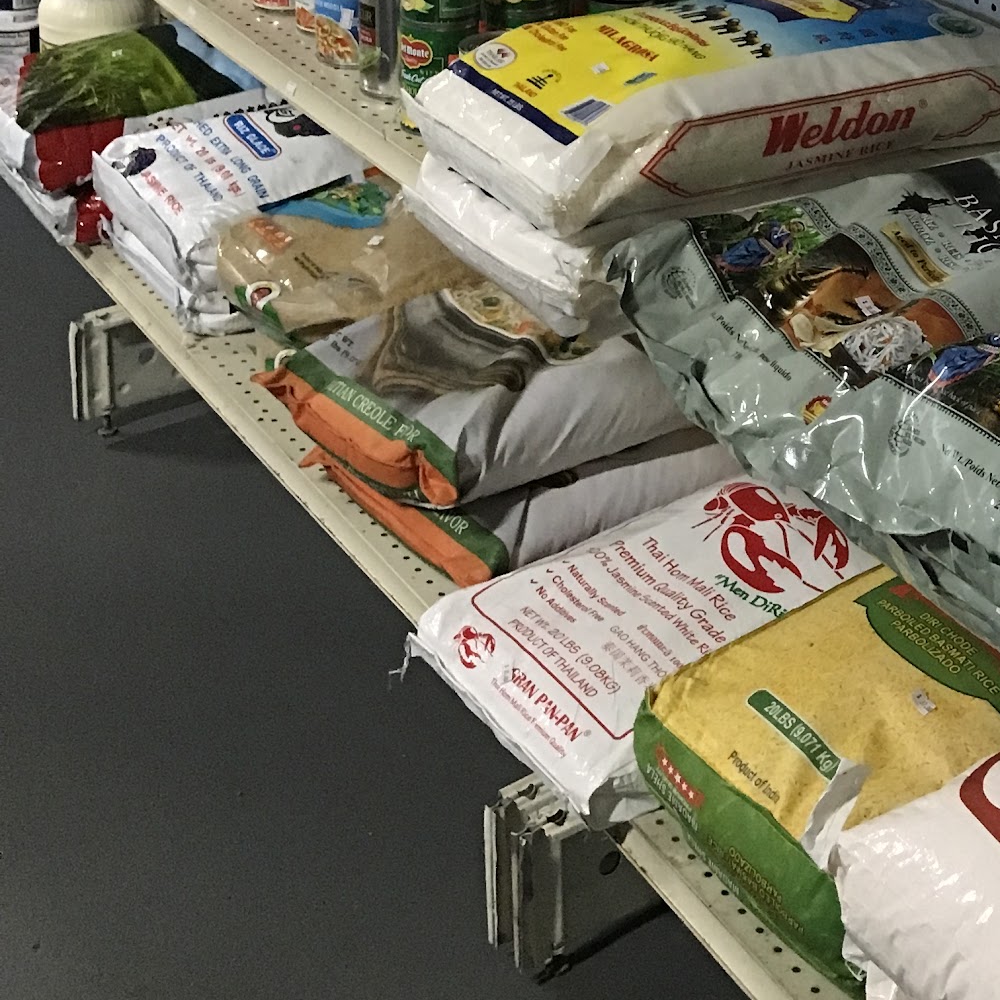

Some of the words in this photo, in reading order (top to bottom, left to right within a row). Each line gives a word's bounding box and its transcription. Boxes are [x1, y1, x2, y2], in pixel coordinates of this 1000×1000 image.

[762, 99, 917, 158] Weldon
[784, 145, 855, 172] JASMINE
[859, 139, 896, 157] RICE
[229, 156, 251, 174] LONG
[247, 174, 270, 199] GRAIN
[352, 394, 398, 431] CREOLE
[535, 585, 548, 600] No
[546, 598, 577, 624] Additives
[552, 575, 592, 613] Cholesterol
[589, 607, 605, 622] Free
[567, 563, 599, 600] Naturally
[609, 539, 656, 587] Premium
[653, 582, 693, 613] Quality
[690, 608, 728, 645] Grade
[643, 536, 669, 563] Thai
[663, 554, 690, 580] Hom
[686, 576, 712, 600] Mali
[710, 593, 736, 623] Rice
[606, 567, 642, 599] Jasmine
[639, 592, 675, 622] Scented
[671, 617, 699, 647] White
[920, 612, 942, 628] DIRI
[940, 626, 978, 656] CHODE
[508, 618, 549, 652] PRODUCT
[542, 646, 559, 659] OF
[553, 656, 599, 698] THAILAND
[520, 606, 537, 621] NET
[548, 626, 566, 640] 20
[559, 636, 582, 655] LBS
[575, 652, 621, 695] (9.08KG)
[609, 625, 630, 642] GAO
[628, 637, 651, 662] HANG
[878, 599, 931, 636] PARBOILED
[929, 634, 976, 671] BASMATI
[972, 669, 1000, 695] RICE
[890, 620, 961, 674] PARBOLIZADO
[512, 667, 540, 699] GRAN
[534, 692, 584, 742] PAN-PAN
[763, 700, 797, 731] 20LBS
[790, 721, 822, 755] (9.071
[815, 750, 838, 774] Kg)
[727, 750, 757, 781] Product
[753, 775, 766, 788] of
[762, 780, 781, 804] India
